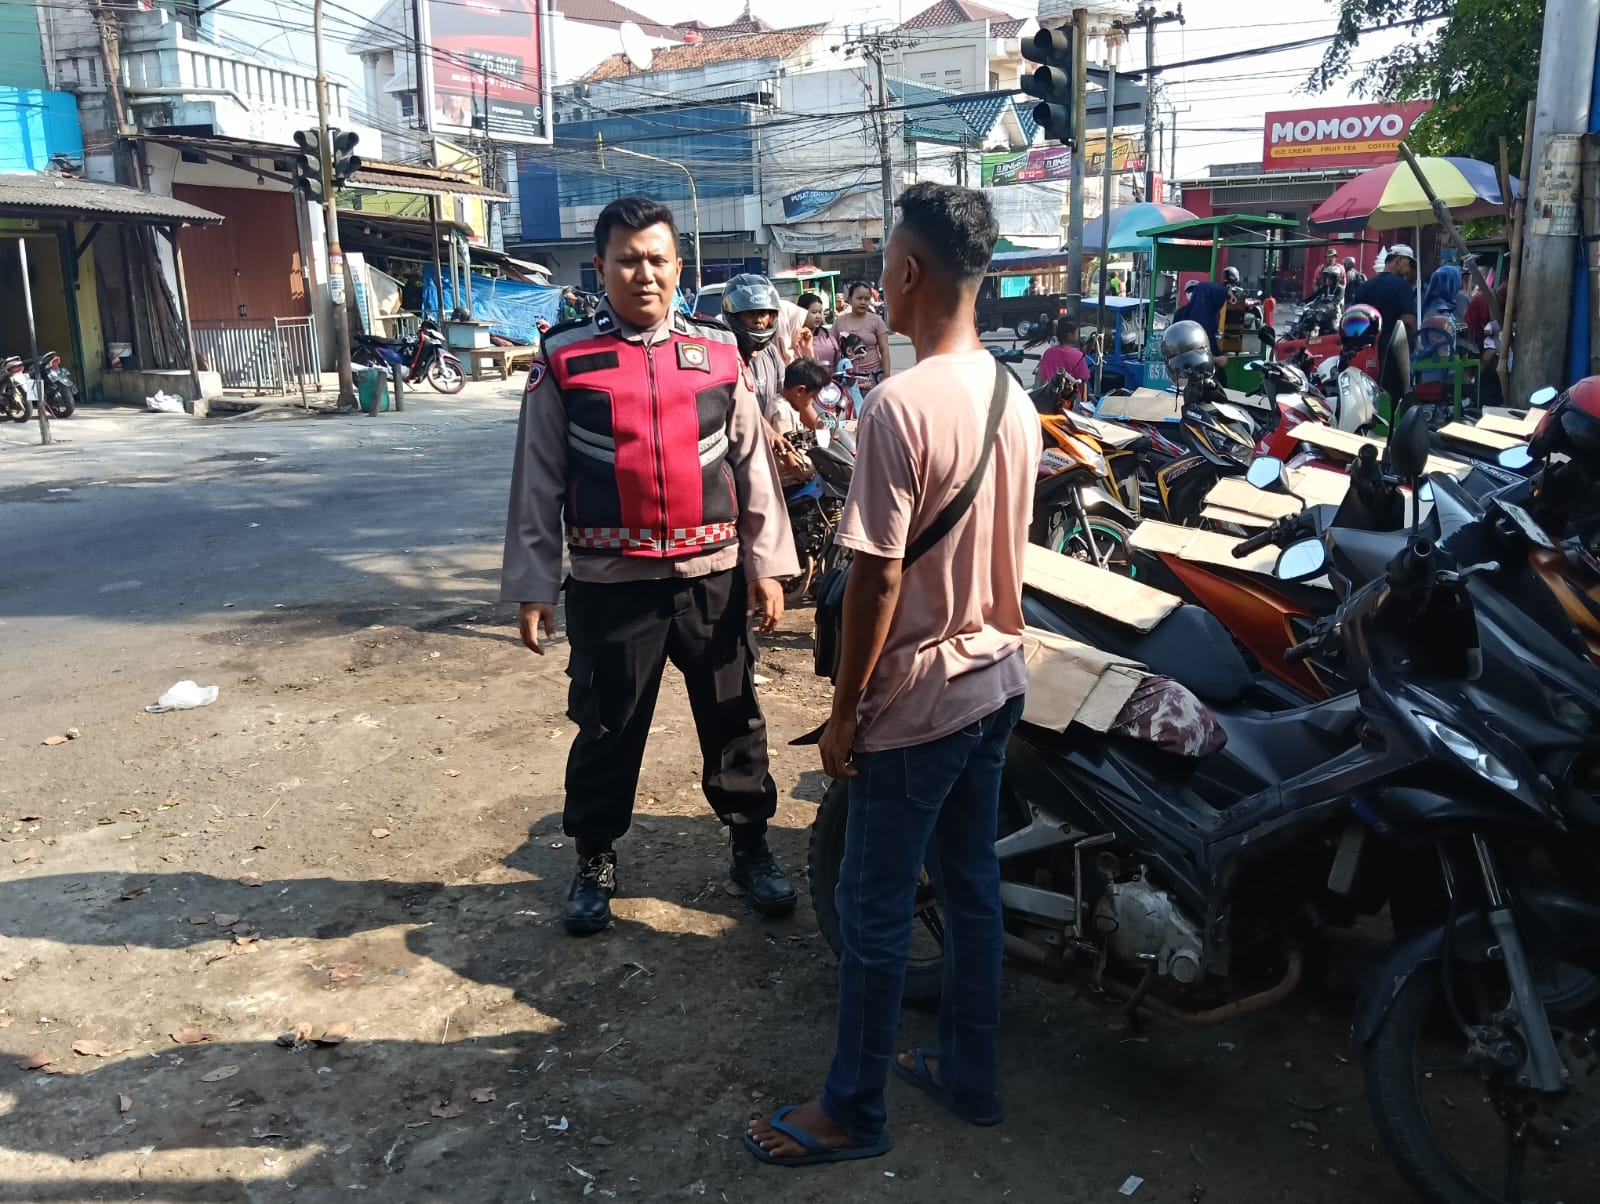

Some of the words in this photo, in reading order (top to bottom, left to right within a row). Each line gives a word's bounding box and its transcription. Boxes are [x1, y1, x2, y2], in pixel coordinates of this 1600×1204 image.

[1271, 114, 1403, 144] MOMOYO
[1288, 147, 1312, 155] CREAM
[1367, 142, 1396, 150] COFFEE
[1046, 452, 1070, 465] HONDA
